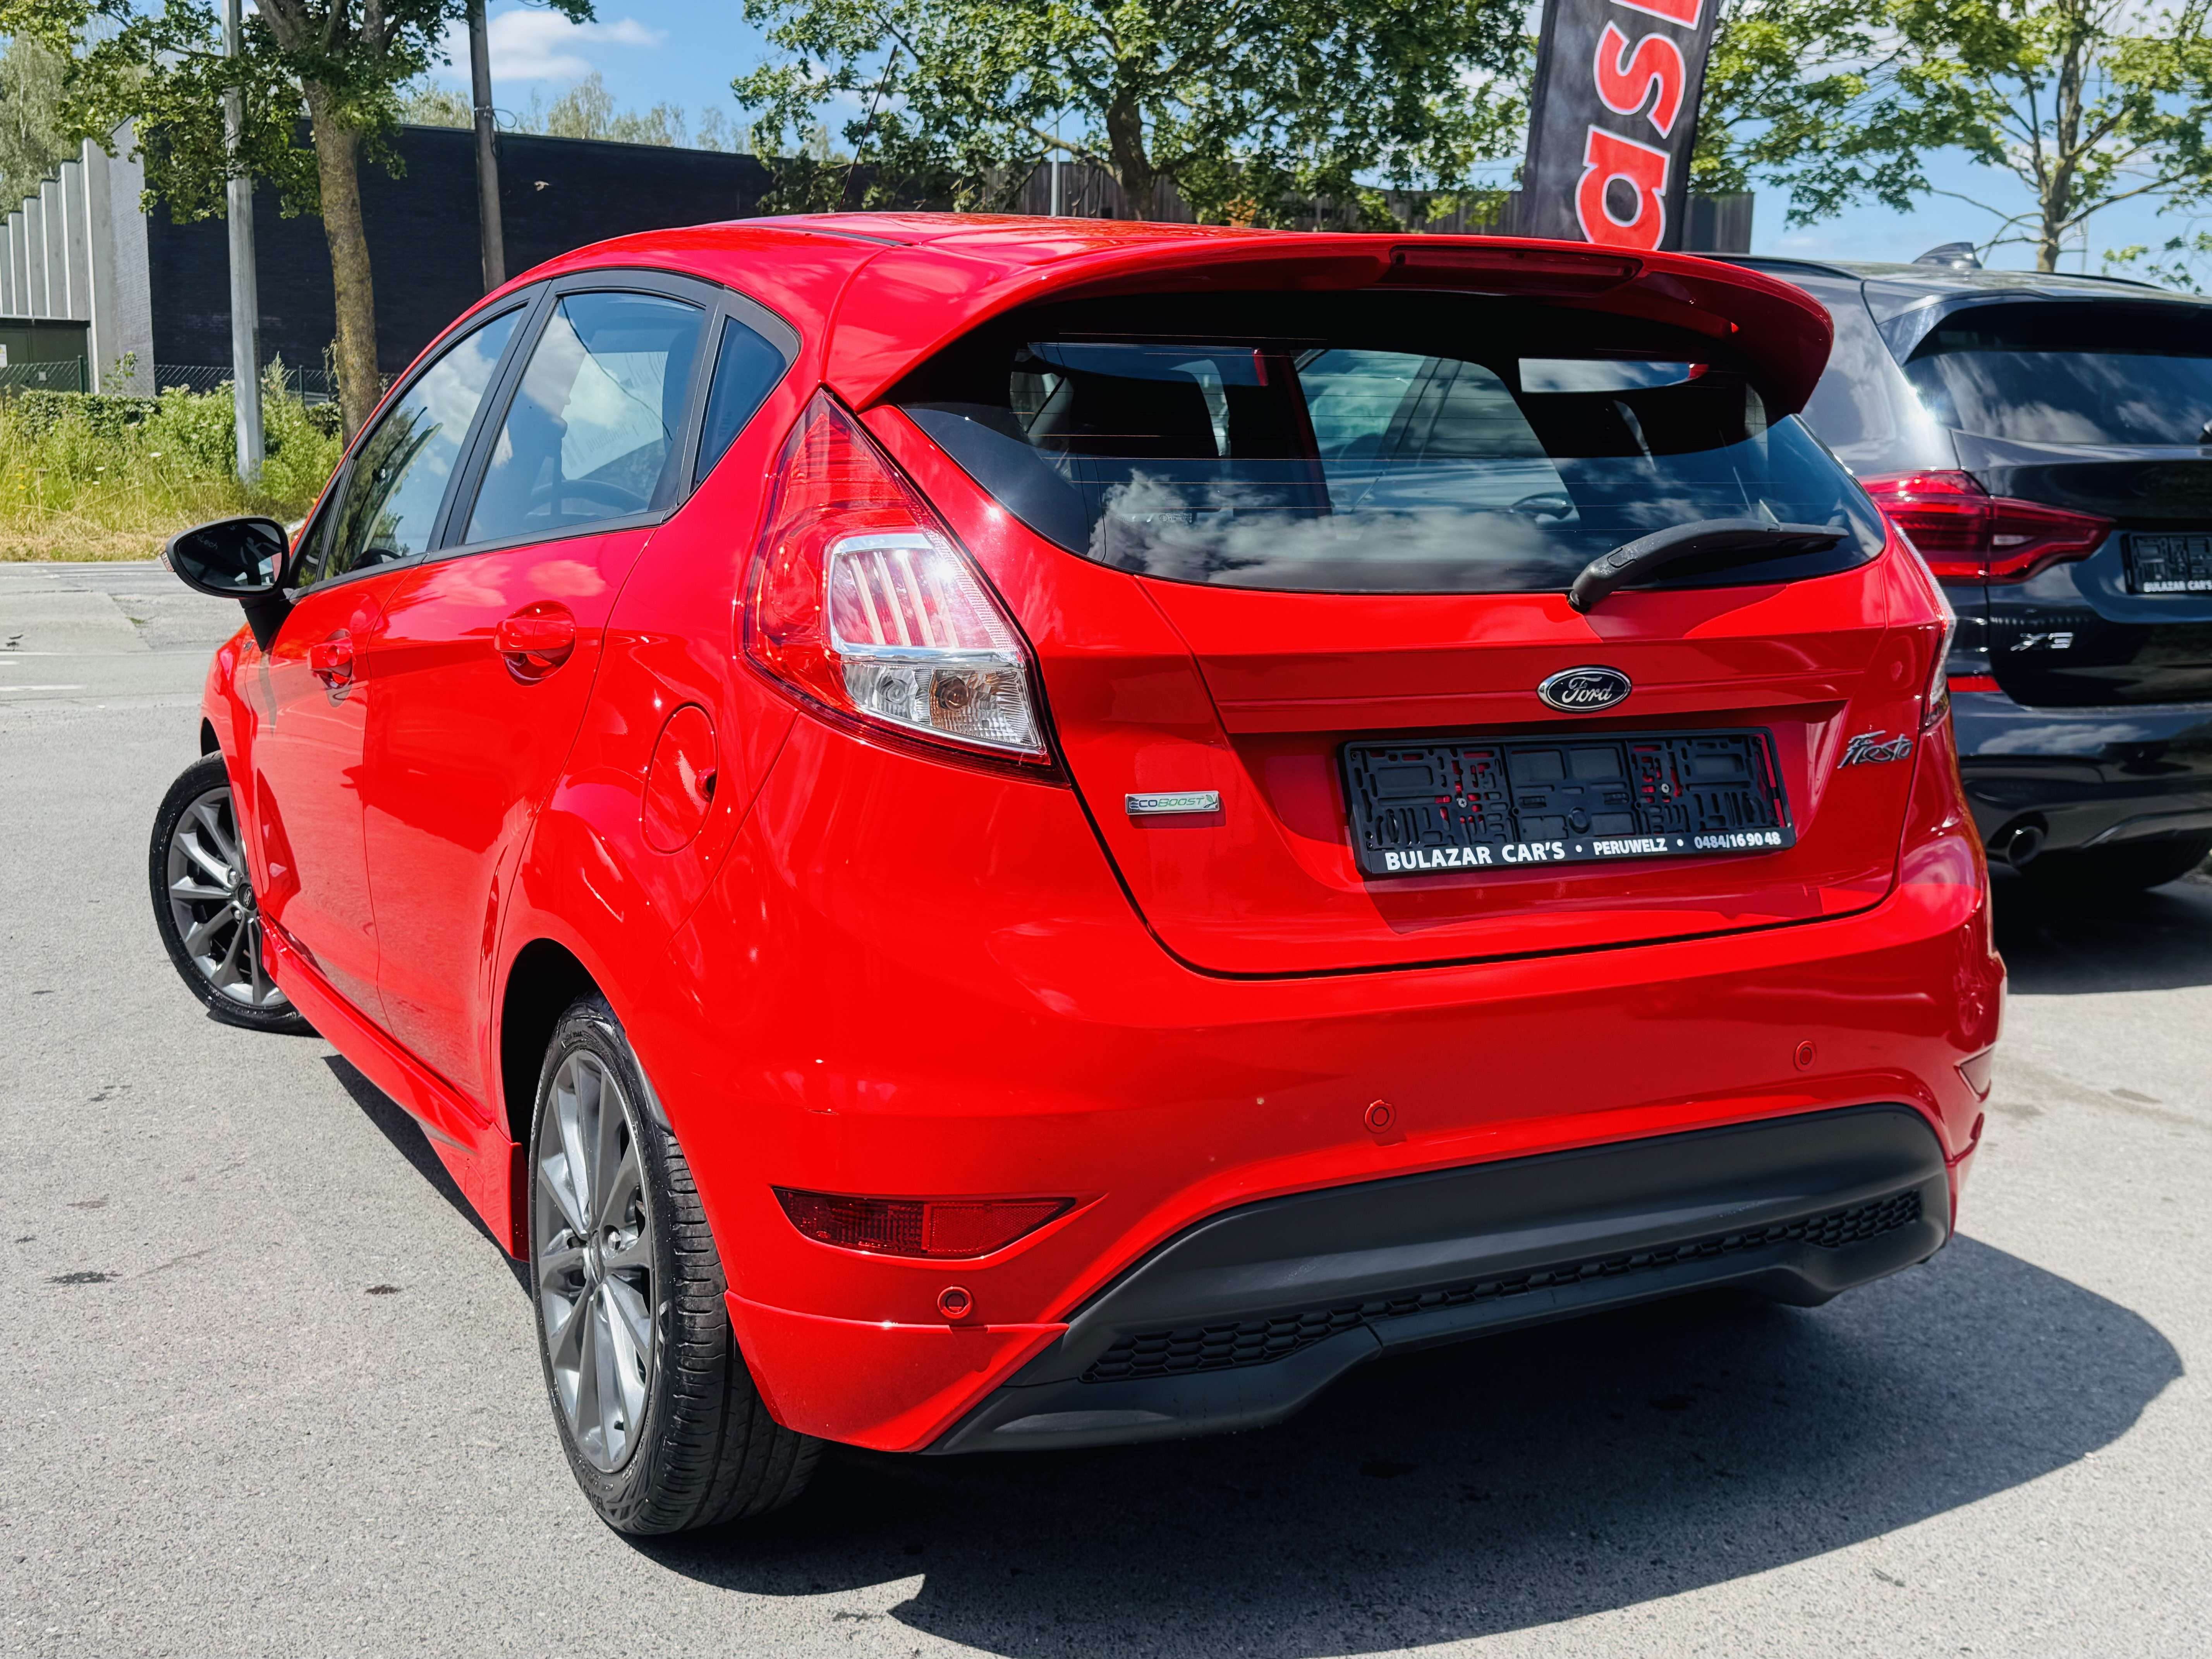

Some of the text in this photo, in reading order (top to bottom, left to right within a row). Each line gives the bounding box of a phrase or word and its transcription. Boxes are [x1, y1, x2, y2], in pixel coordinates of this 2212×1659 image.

[2010, 632, 2073, 651] X3
[1562, 677, 1614, 703] Ford
[1837, 730, 1913, 769] Fiesta
[1385, 846, 1493, 871] BULAZAR
[1501, 842, 1565, 863] CAR'S
[1593, 838, 1668, 855] PERUWELZ
[1694, 833, 1746, 849] 0484/16
[1764, 831, 1781, 845] 48
